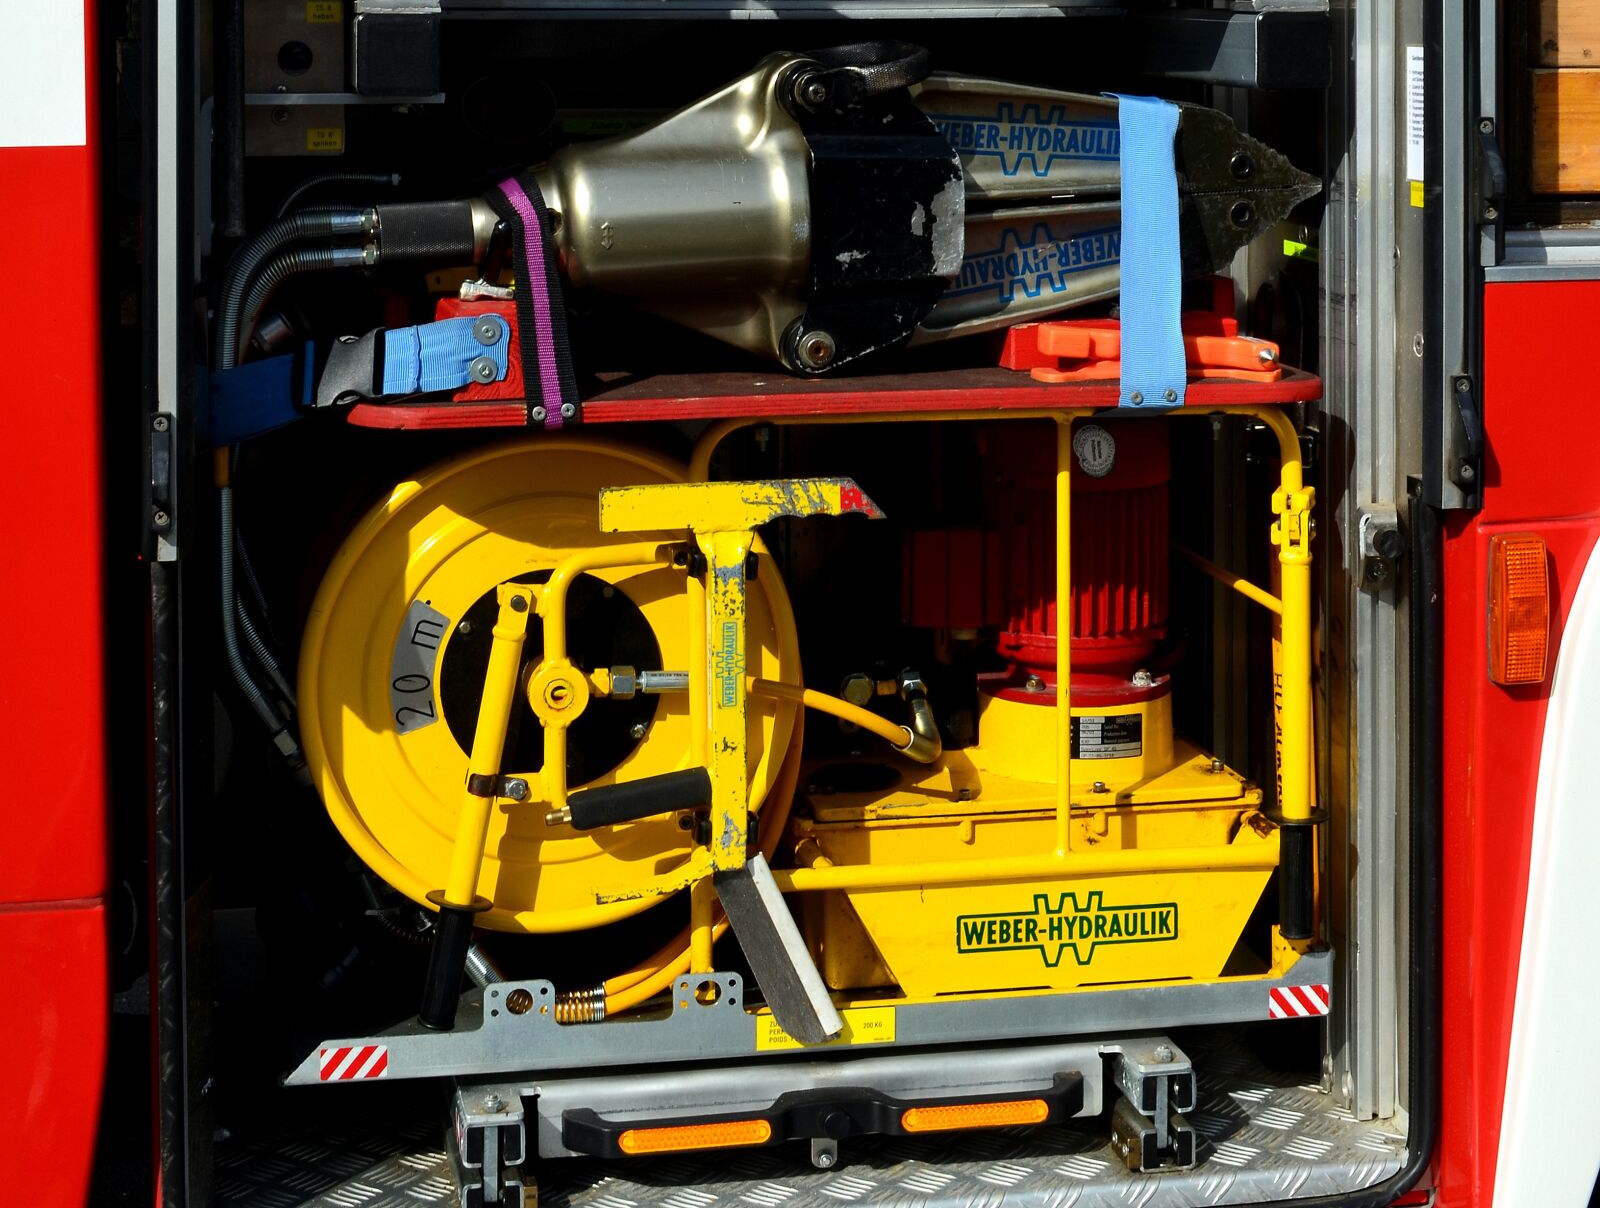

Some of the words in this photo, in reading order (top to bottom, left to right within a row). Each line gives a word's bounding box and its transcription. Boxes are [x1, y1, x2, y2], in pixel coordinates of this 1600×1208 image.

[725, 625, 735, 704] WEBER-HYDRAULIK
[392, 674, 435, 726] 20
[963, 909, 1172, 946] WEBER-HYDRAULIK
